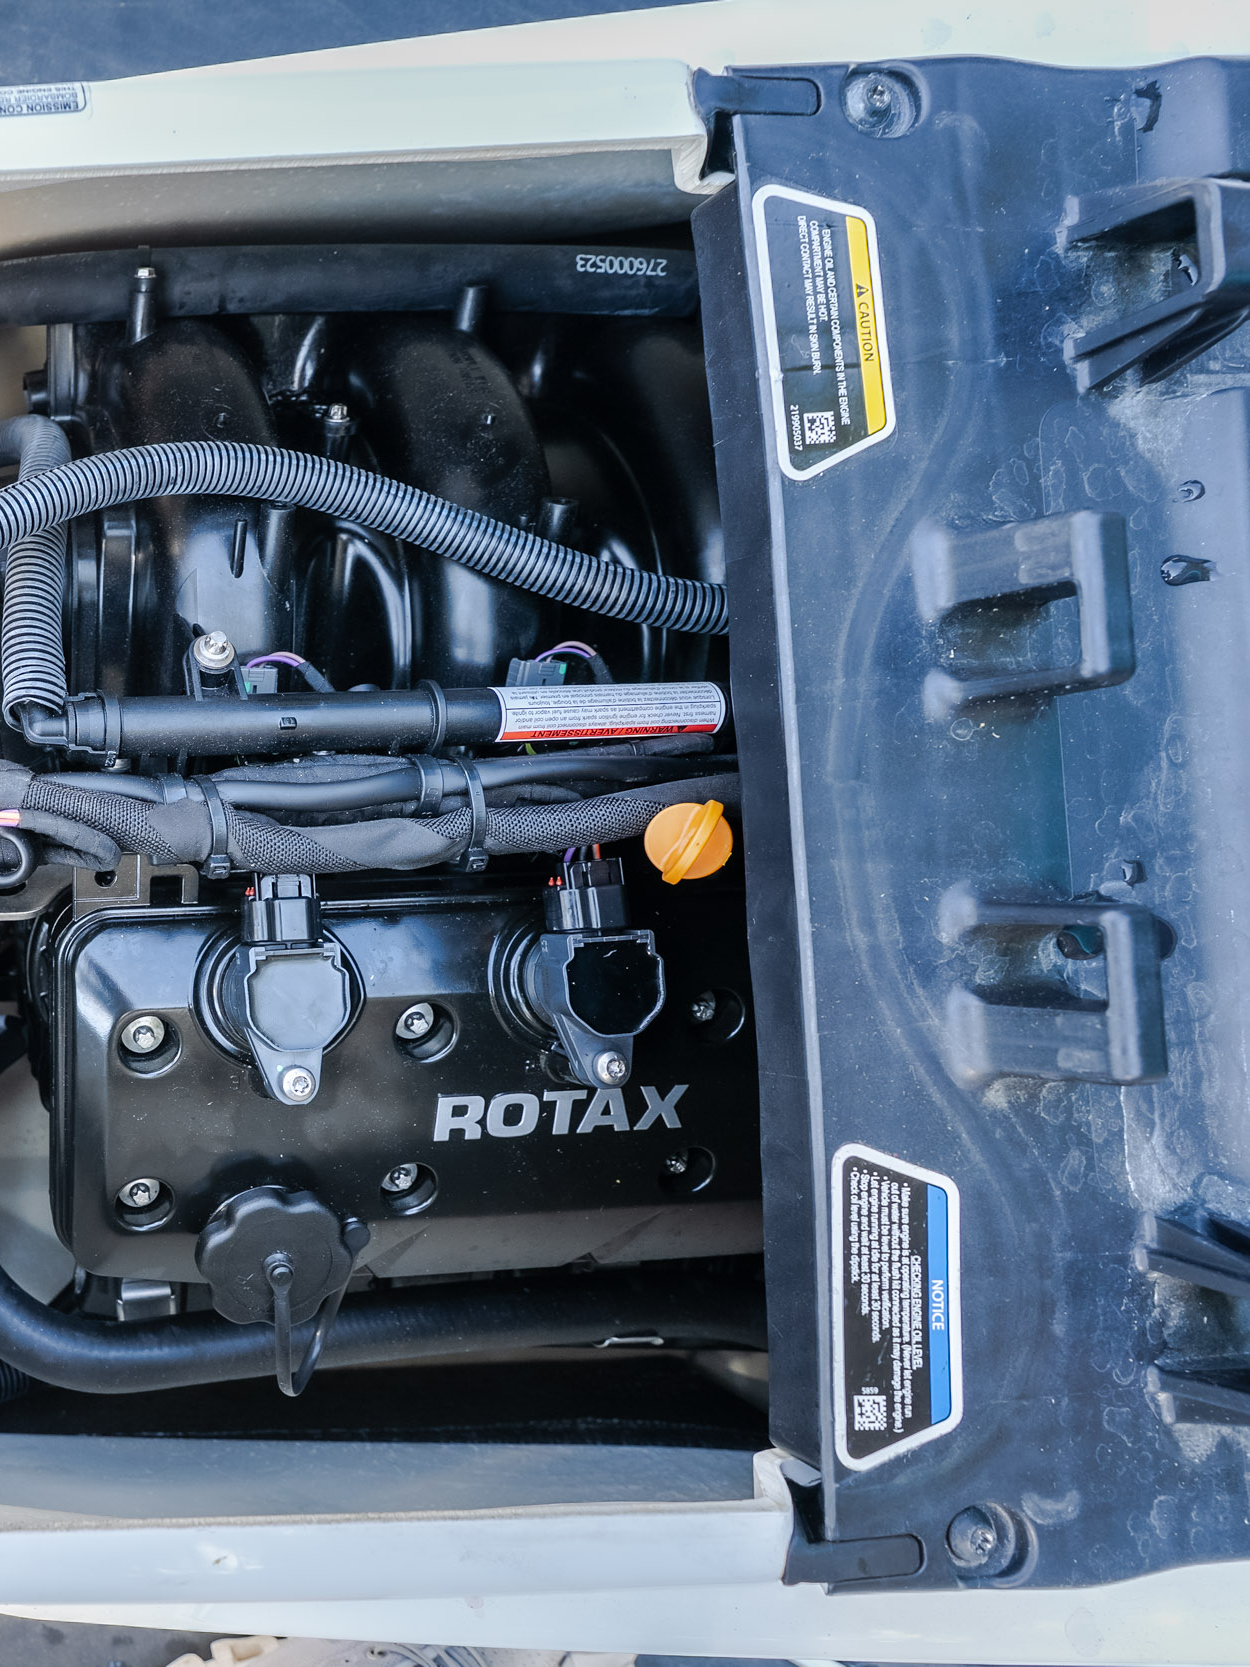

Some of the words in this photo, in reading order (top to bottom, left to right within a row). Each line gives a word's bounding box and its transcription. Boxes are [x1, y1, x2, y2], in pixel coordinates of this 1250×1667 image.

[13, 91, 77, 103] BOMBARDIER
[26, 100, 78, 112] EMISSION
[797, 215, 808, 243] DIRECT
[809, 220, 823, 277] COMPARTMENT
[821, 228, 832, 257] ENGINE
[575, 254, 667, 276] 276000523
[799, 243, 811, 278] CONTACT
[824, 257, 834, 270] OIL
[803, 279, 813, 295] MAY
[815, 277, 824, 293] MAY
[825, 270, 835, 286] AND
[816, 293, 825, 304] BE
[827, 287, 839, 318] CERTAIN
[805, 295, 816, 324] RESULT
[818, 305, 827, 322] HOT.
[808, 325, 817, 333] IN
[857, 301, 874, 362] CAUTION
[809, 333, 819, 351] SKIN
[830, 319, 844, 371] COMPONENTS
[811, 351, 821, 375] BURN.
[836, 372, 845, 380] IN
[836, 380, 847, 396] THE
[838, 396, 850, 425] ENGINE
[790, 404, 802, 451] 219905037
[530, 727, 618, 737] AVERTISSEMENT
[624, 725, 674, 734] WARNING
[433, 1084, 689, 1142] ROTAX
[850, 1171, 859, 1194] Check
[859, 1173, 869, 1190] Stop
[870, 1176, 880, 1187] Let
[890, 1182, 899, 1194] out
[850, 1194, 859, 1203] oil
[868, 1188, 879, 1212] engine
[880, 1180, 890, 1205] Vehicle
[890, 1194, 900, 1203] of
[901, 1187, 910, 1206] Make
[858, 1191, 869, 1215] engine
[850, 1204, 859, 1221] level
[881, 1206, 889, 1224] must
[891, 1203, 899, 1222] water
[901, 1207, 909, 1223] sure
[848, 1222, 859, 1241] using
[860, 1216, 869, 1230] and
[869, 1213, 879, 1240] running
[881, 1225, 889, 1234] be
[860, 1231, 869, 1245] wait
[871, 1240, 879, 1248] at
[881, 1235, 889, 1252] level
[891, 1223, 900, 1248] without
[899, 1224, 910, 1248] engine
[850, 1242, 859, 1253] the
[871, 1249, 880, 1262] idle
[891, 1249, 900, 1261] the
[848, 1254, 860, 1283] dipstick.
[860, 1254, 869, 1272] least
[871, 1262, 880, 1273] for
[901, 1256, 910, 1264] at
[861, 1273, 870, 1283] 30
[871, 1273, 879, 1281] at
[879, 1261, 890, 1289] perform
[891, 1262, 900, 1279] flush
[911, 1255, 921, 1298] CHECKING
[871, 1281, 880, 1299] least
[891, 1280, 900, 1289] kit
[900, 1264, 910, 1298] operating
[860, 1283, 870, 1315] seconds.
[871, 1300, 880, 1310] 30
[891, 1289, 900, 1326] connected
[931, 1279, 944, 1330] NOTICE
[881, 1290, 891, 1329] verification.
[912, 1298, 921, 1329] ENGINE
[871, 1311, 881, 1343] seconds.
[900, 1299, 910, 1343] temperature.
[892, 1327, 899, 1336] as
[912, 1330, 922, 1343] OIL
[890, 1343, 900, 1359] may
[901, 1344, 911, 1368] (Never
[912, 1344, 922, 1369] LEVEL
[890, 1359, 902, 1390] damage
[903, 1369, 912, 1379] let
[893, 1390, 902, 1402] the
[902, 1379, 913, 1404] engine
[891, 1403, 904, 1433] engine.)
